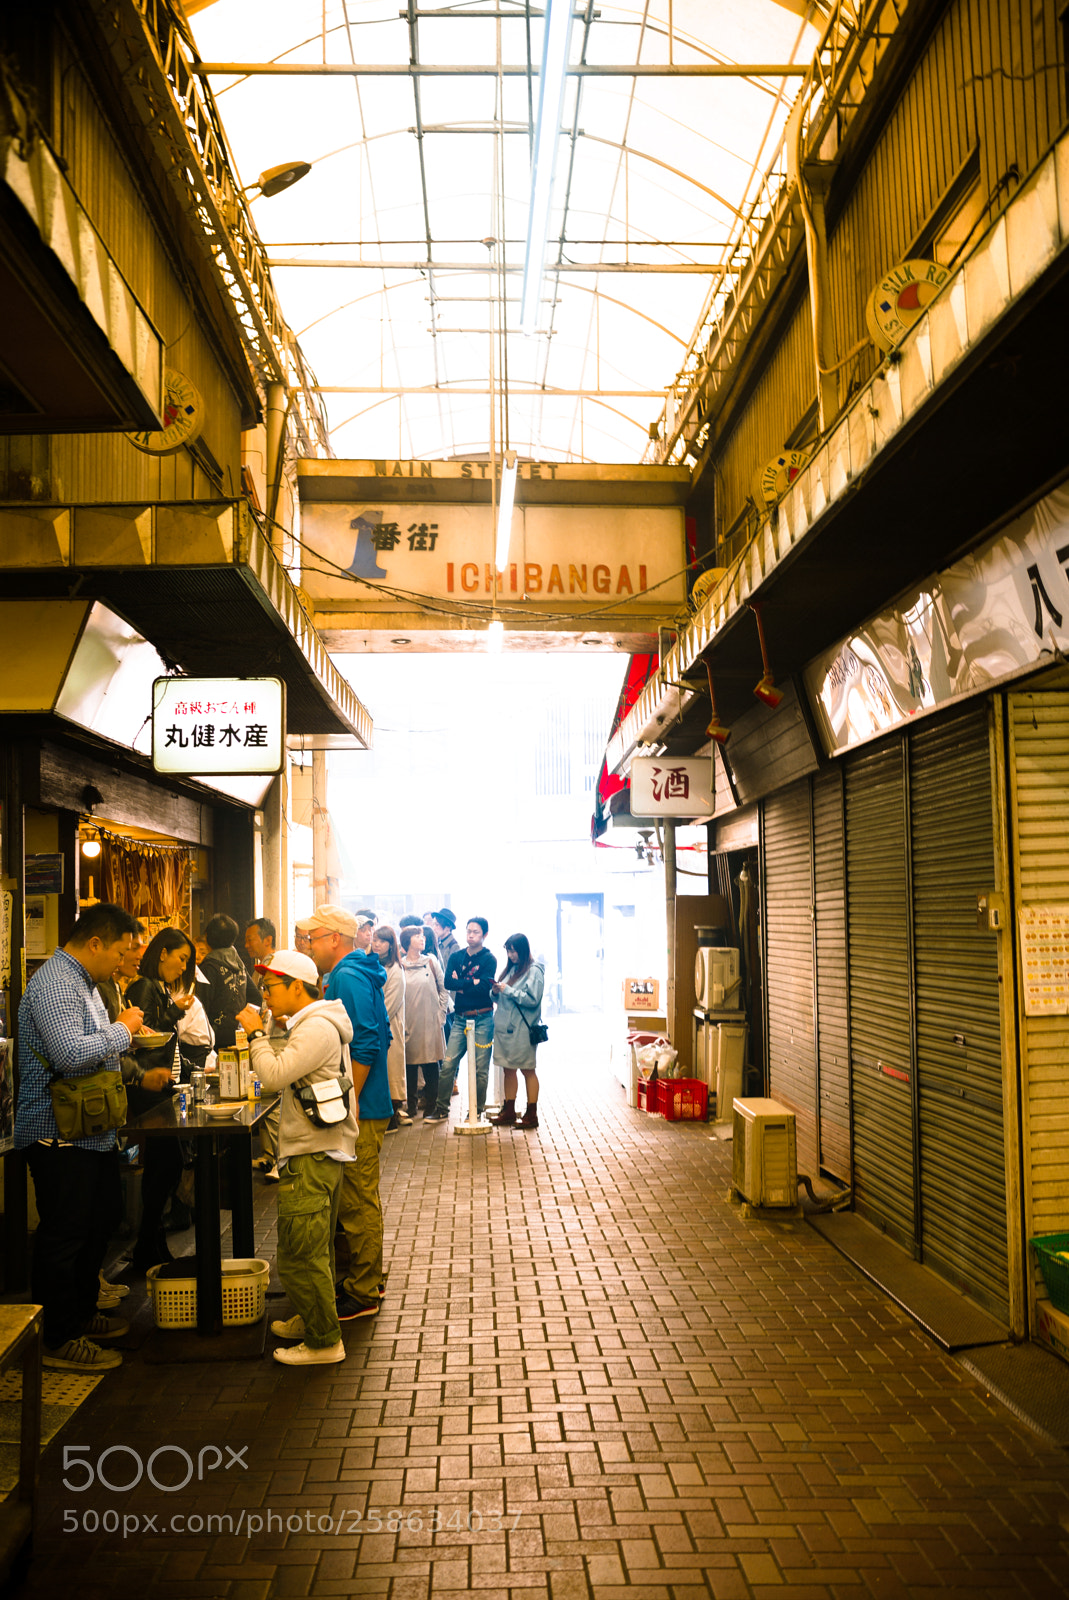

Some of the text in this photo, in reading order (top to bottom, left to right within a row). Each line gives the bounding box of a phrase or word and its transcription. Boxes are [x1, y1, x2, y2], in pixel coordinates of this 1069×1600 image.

[881, 264, 915, 294] SILK
[374, 461, 433, 477] MAIN
[446, 562, 648, 595] ICHIBANGAI
[174, 701, 257, 716] 高級おでん種
[164, 723, 269, 748] 丸健水産
[650, 766, 690, 802] 酒
